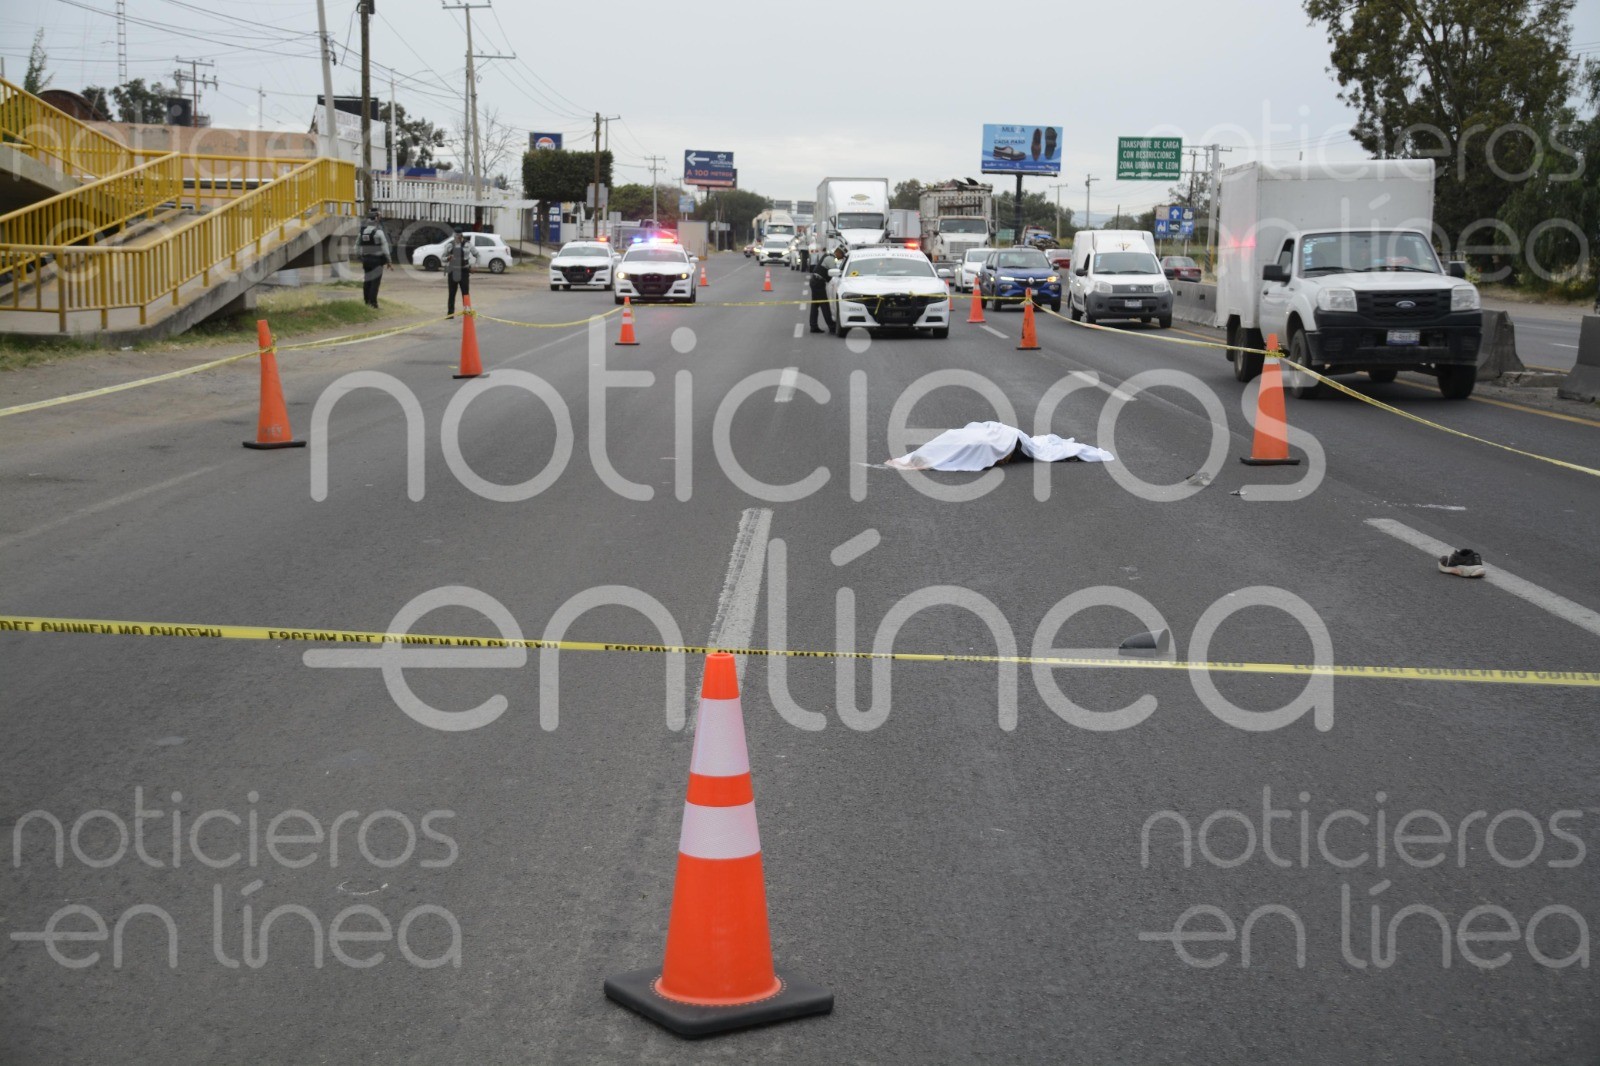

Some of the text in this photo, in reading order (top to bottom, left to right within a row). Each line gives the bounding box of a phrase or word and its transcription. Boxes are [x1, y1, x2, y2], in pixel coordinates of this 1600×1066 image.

[1120, 140, 1180, 149] TRANSPORTE DE CARGA
[1122, 150, 1176, 159] CON RESTRICCIONES
[1119, 161, 1133, 169] ZONA
[1134, 161, 1155, 169] URBANA
[1157, 161, 1164, 169] DE
